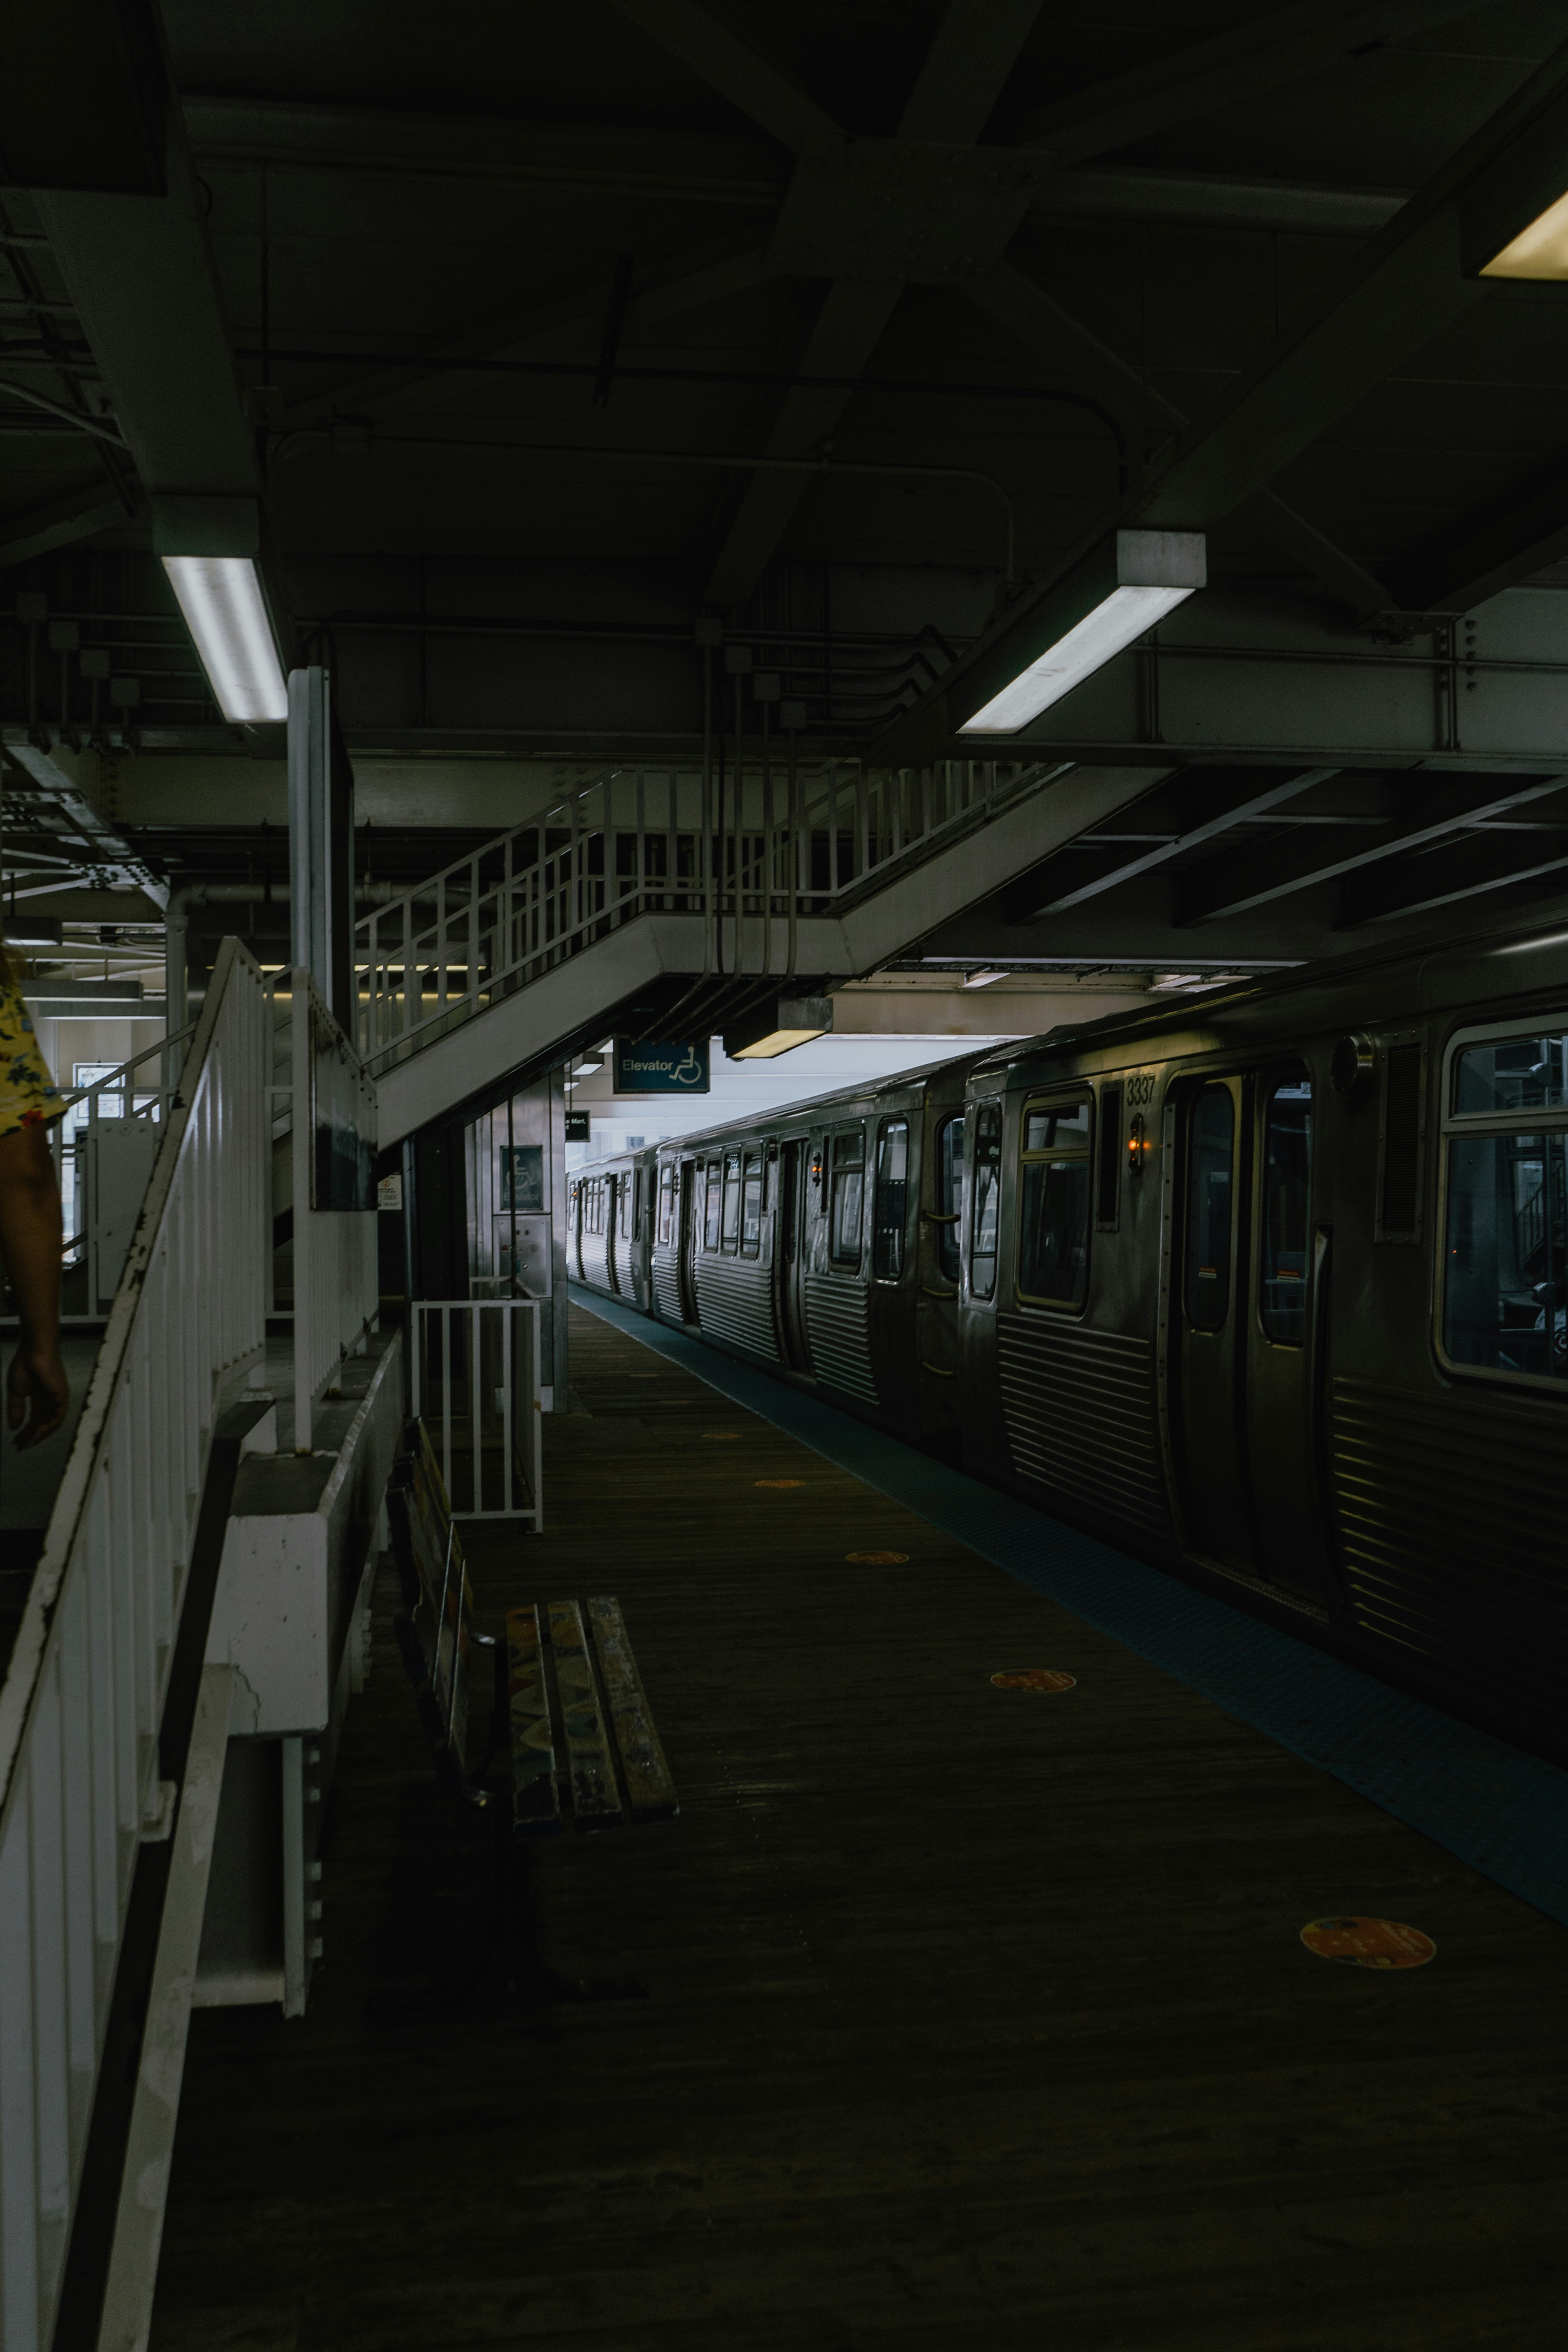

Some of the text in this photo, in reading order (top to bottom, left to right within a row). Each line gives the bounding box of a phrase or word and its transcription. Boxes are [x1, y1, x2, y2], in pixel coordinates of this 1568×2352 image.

[622, 1060, 673, 1071] Elevator
[1127, 1075, 1155, 1107] 3337
[504, 1192, 540, 1200] Evator
